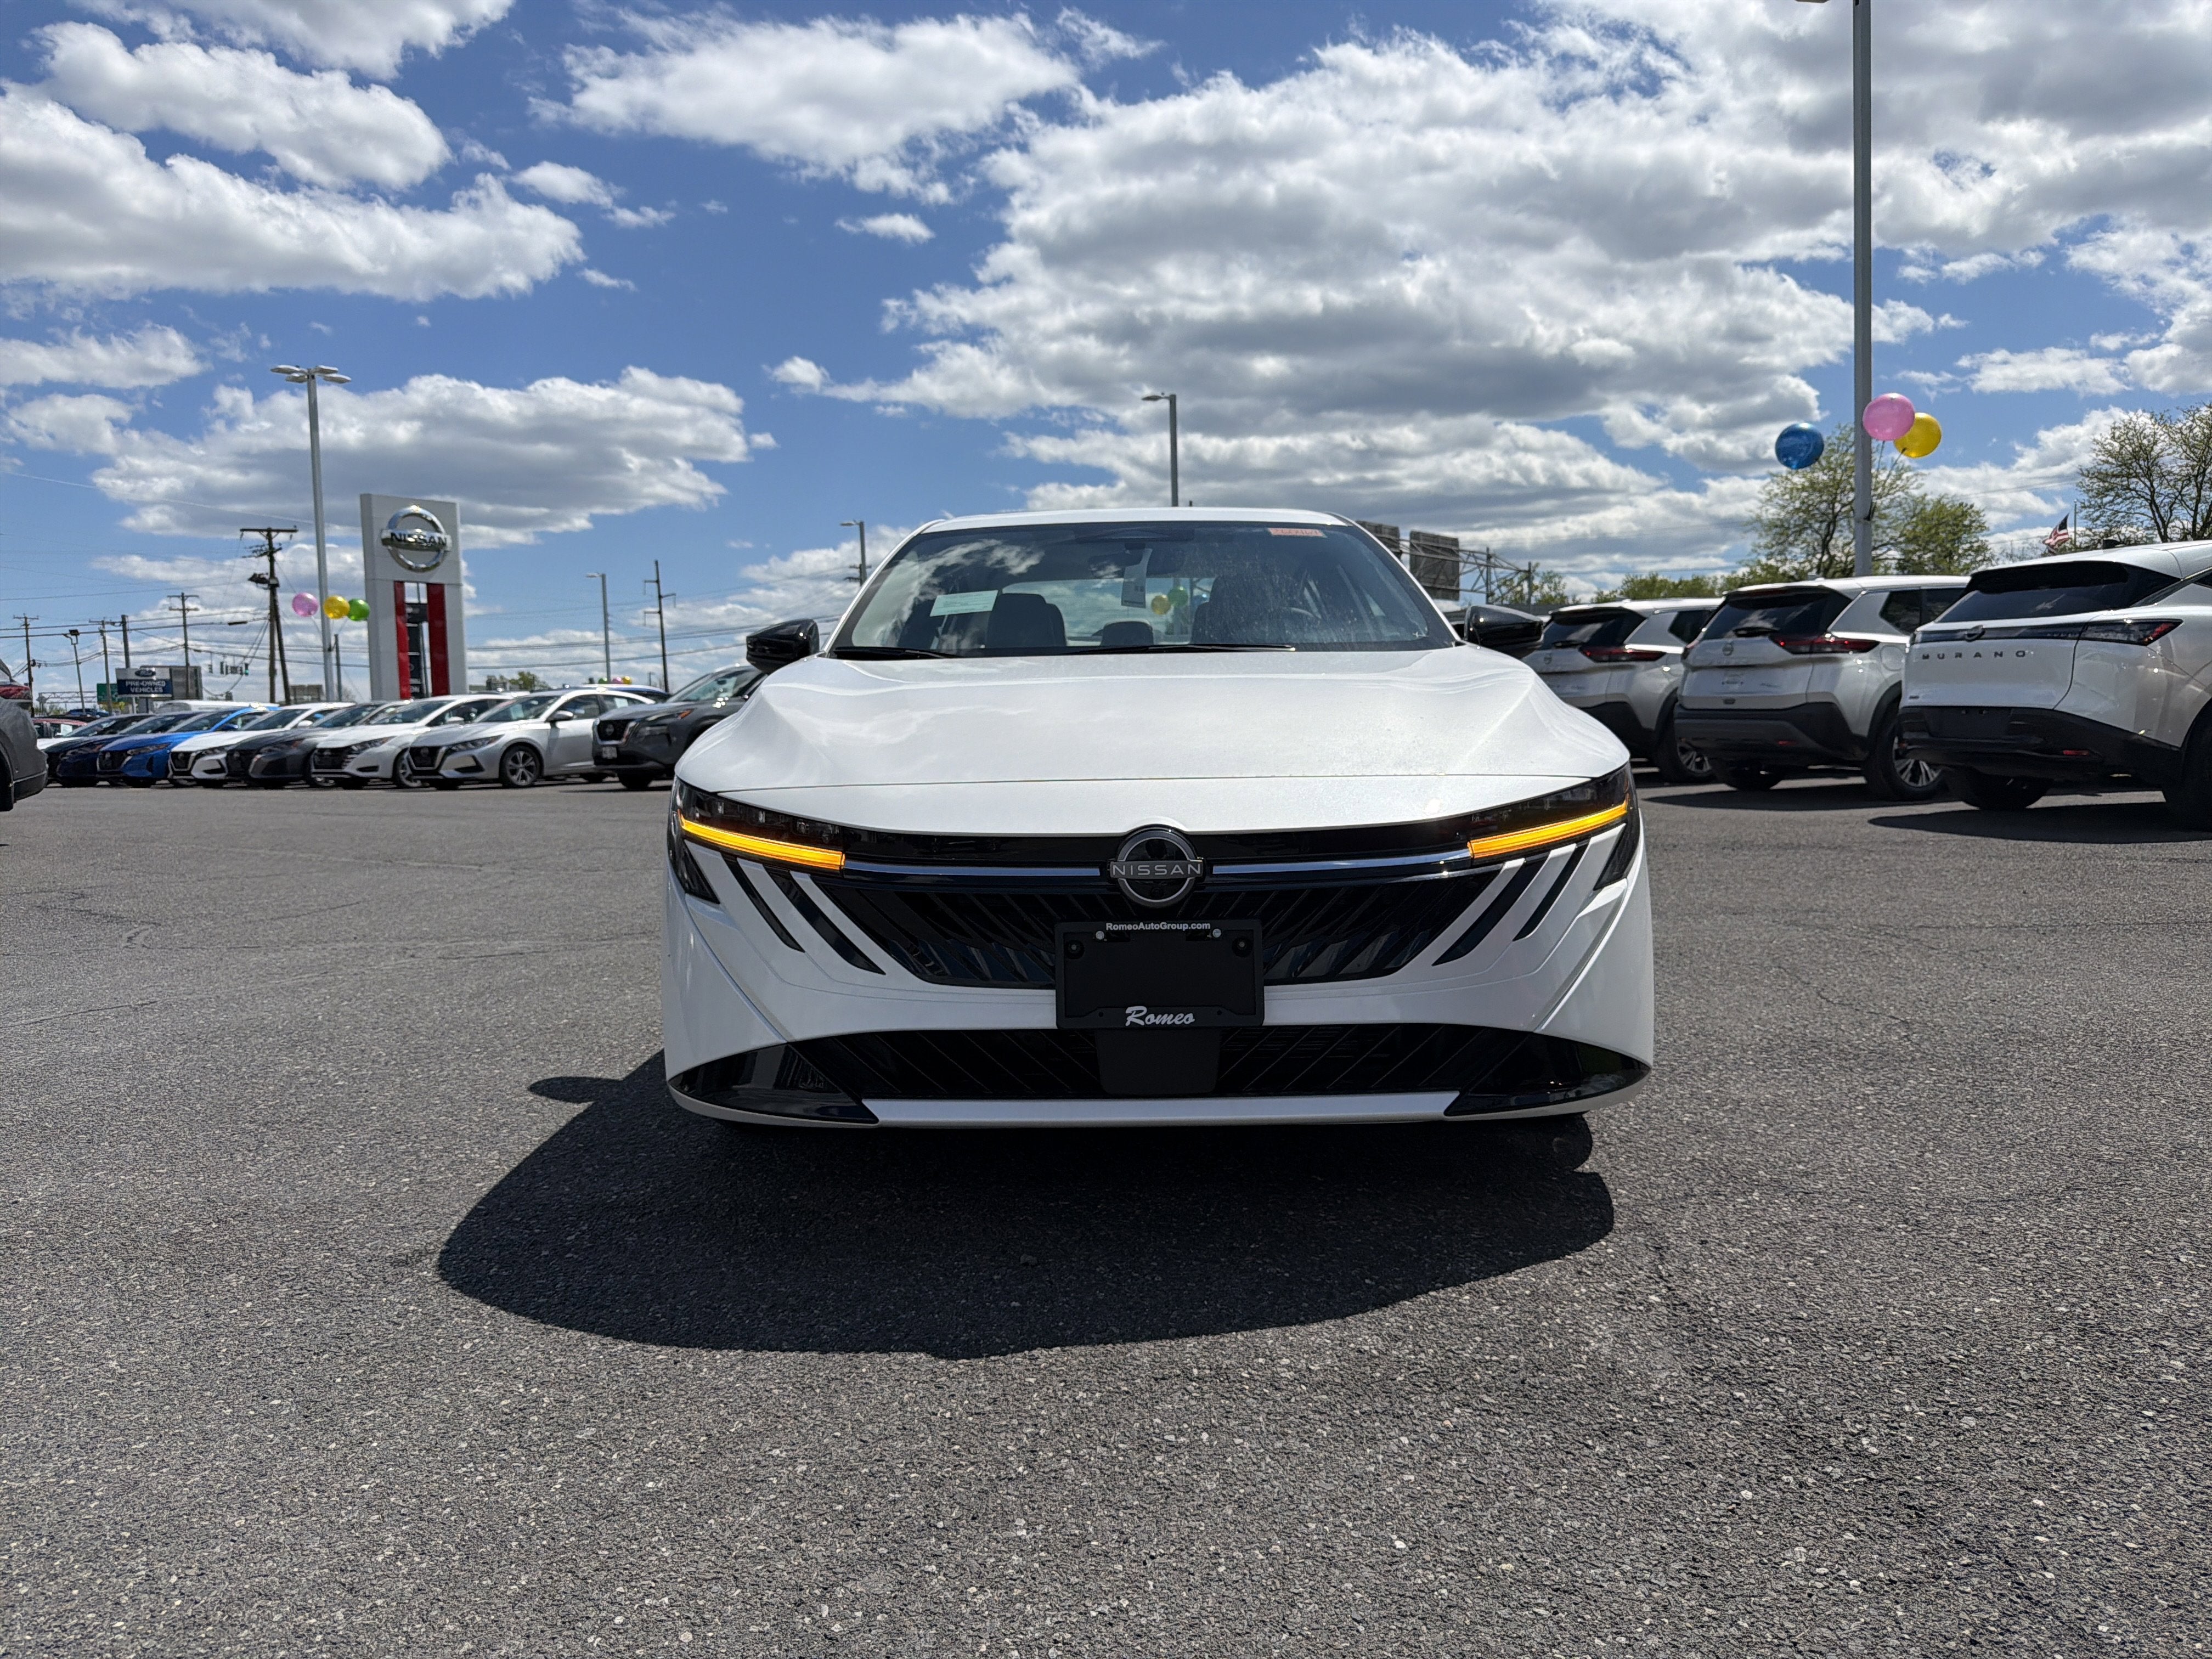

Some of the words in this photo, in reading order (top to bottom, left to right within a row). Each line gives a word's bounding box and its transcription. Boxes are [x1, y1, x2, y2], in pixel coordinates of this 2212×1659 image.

[390, 532, 447, 547] NISSAN
[1922, 650, 2026, 660] MURANO
[1112, 864, 1201, 876] NISSAN
[1105, 922, 1211, 932] RomeoAutoGroup.com
[1125, 1006, 1195, 1027] Romeo
